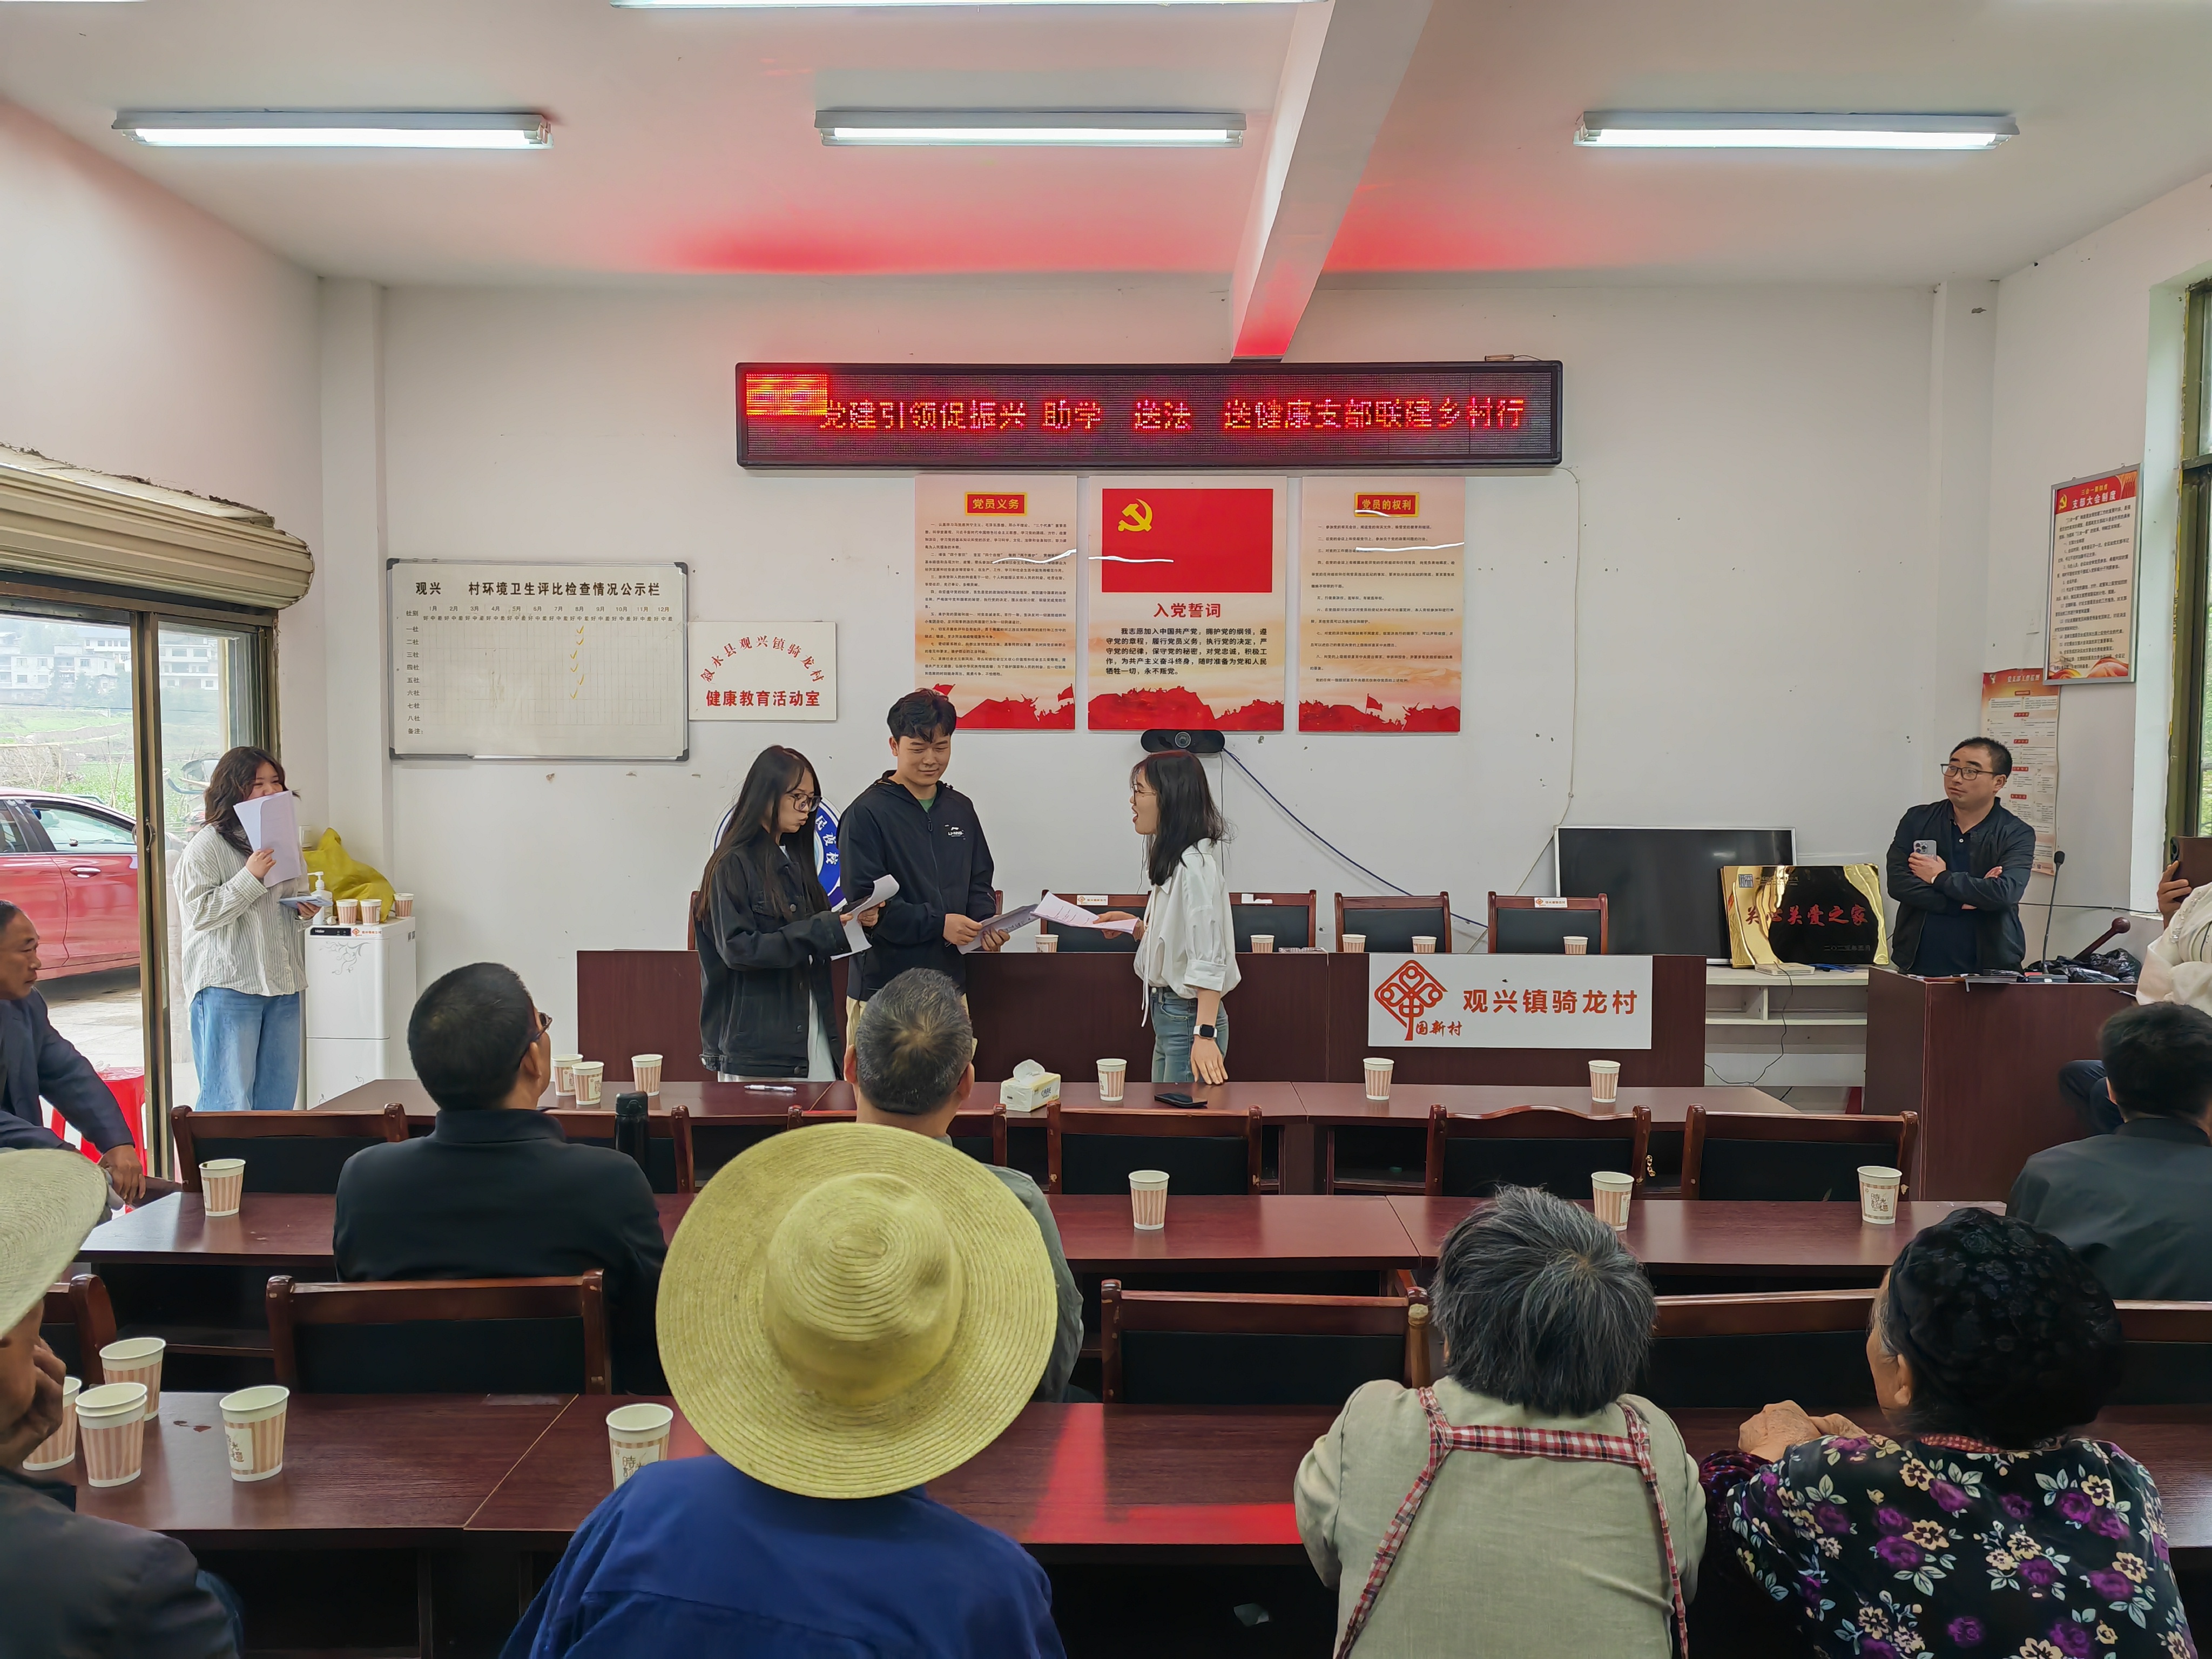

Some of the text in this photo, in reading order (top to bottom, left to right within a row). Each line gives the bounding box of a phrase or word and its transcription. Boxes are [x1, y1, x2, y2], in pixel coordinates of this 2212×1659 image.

[820, 399, 1026, 429] 党建引领促振兴
[1041, 400, 1102, 429] 助学
[1134, 399, 1191, 430] 送法
[972, 498, 1020, 509] 党员义务
[1361, 499, 1412, 511] 党员的权利
[415, 582, 660, 597] 观兴 村环境卫生评比检查情况公示栏
[1153, 603, 1221, 618] 入党誓词
[706, 690, 820, 706] 健康教育活动室
[1462, 989, 1638, 1015] 观兴镇骑龙村
